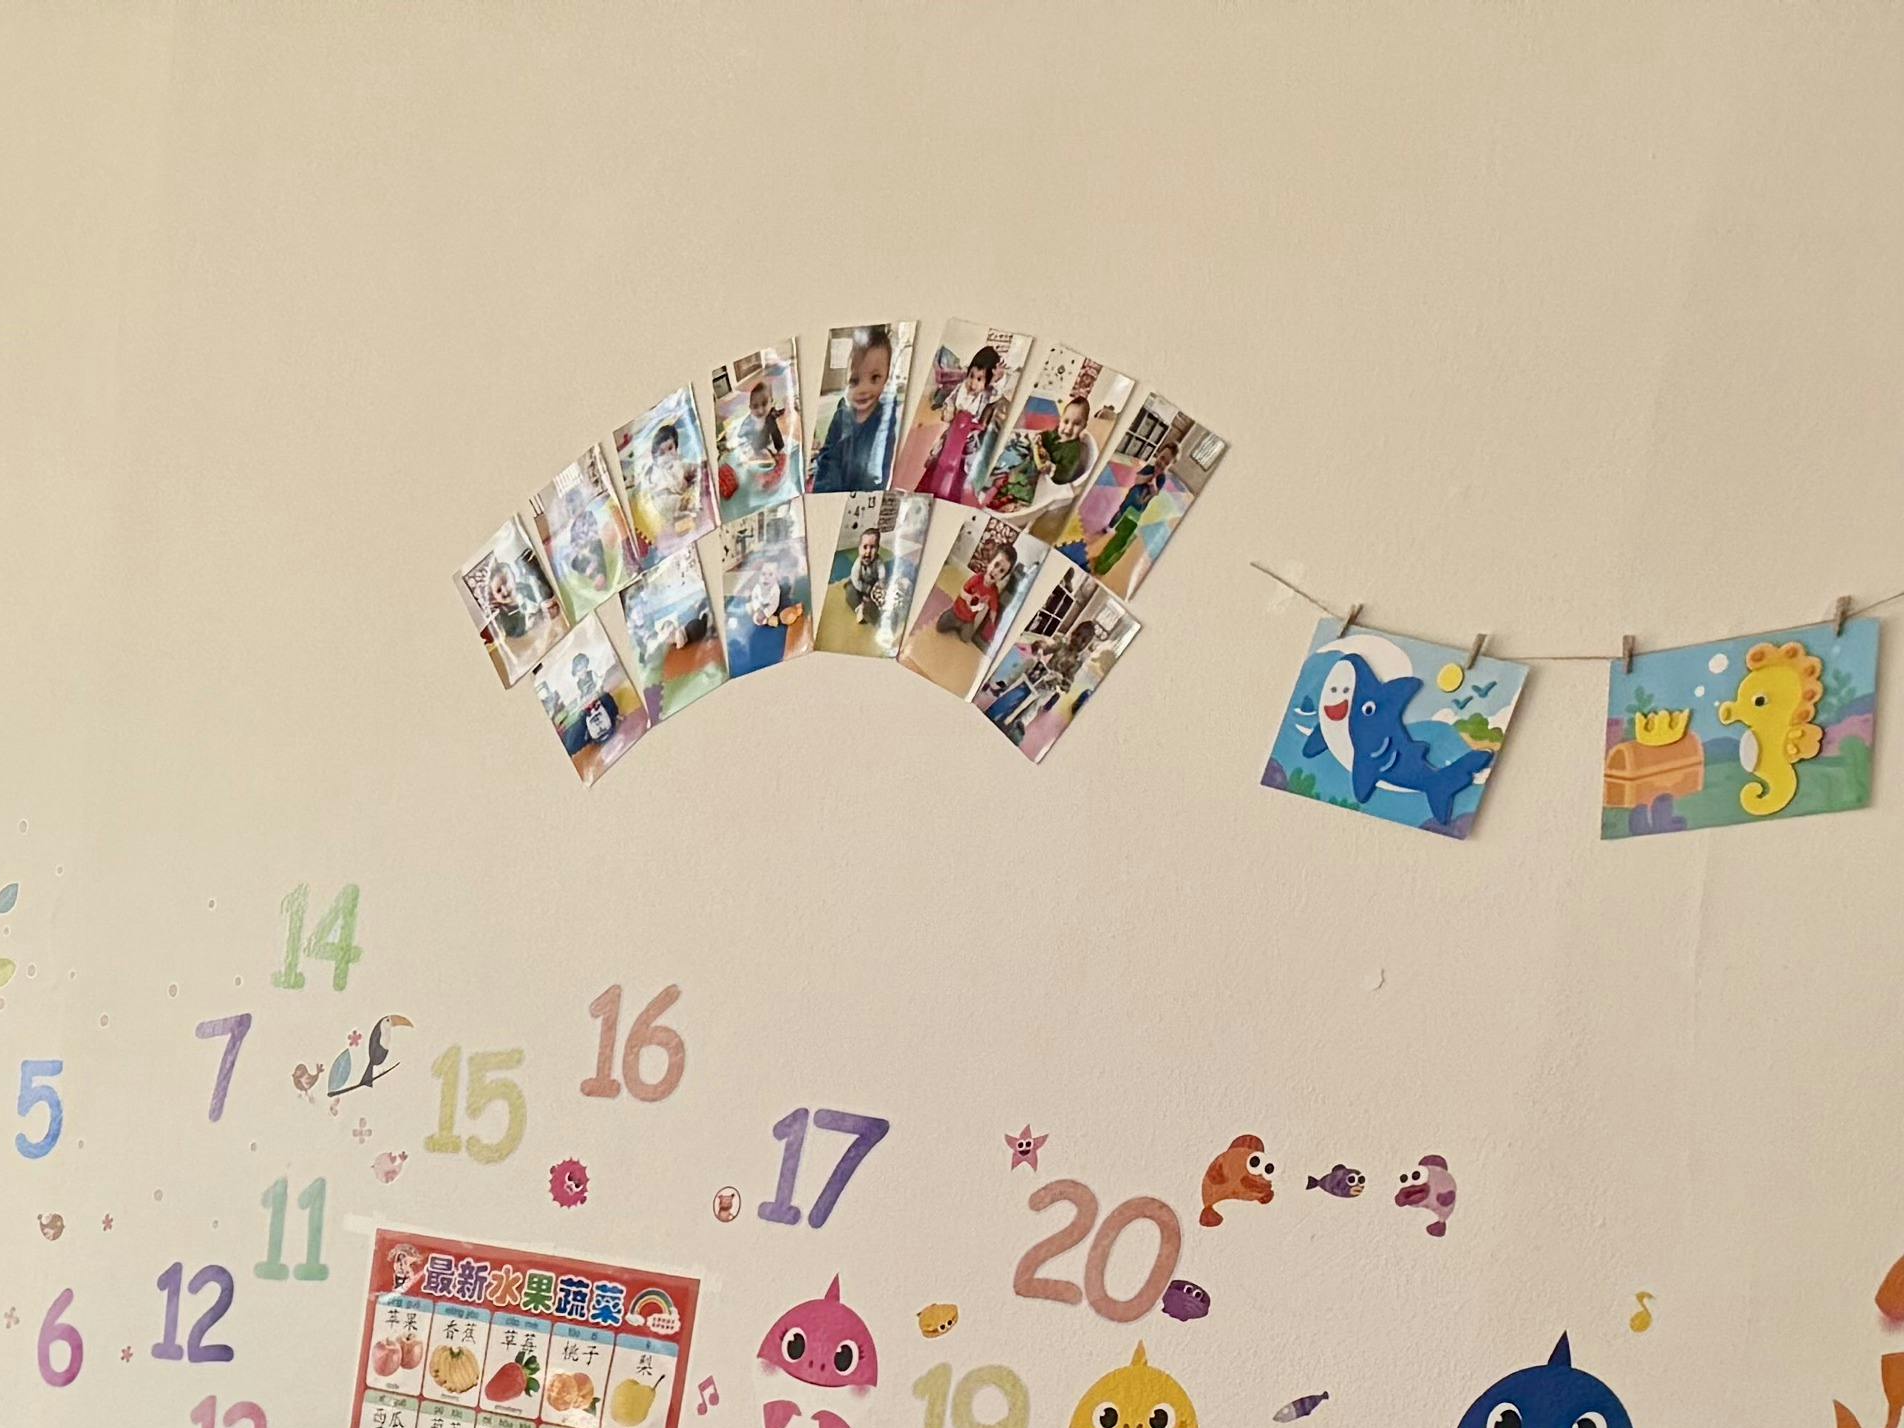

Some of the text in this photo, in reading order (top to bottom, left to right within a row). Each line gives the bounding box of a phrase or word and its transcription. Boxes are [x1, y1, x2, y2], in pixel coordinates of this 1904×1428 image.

[270, 883, 362, 991] 14
[196, 1013, 252, 1121] 7
[579, 983, 685, 1102] 16
[15, 1059, 63, 1159] 5
[423, 1044, 528, 1164] 15
[757, 1106, 890, 1229] 17
[254, 1176, 330, 1281] 11
[1015, 1179, 1184, 1323] 20
[37, 1288, 84, 1388] 6
[151, 1262, 235, 1363] 12
[423, 1255, 625, 1326] 最新水果蔬菜
[443, 1320, 476, 1344] 香蕉
[501, 1329, 537, 1354] 草莓
[562, 1341, 599, 1366] 桃子
[373, 1408, 404, 1428] 西瓜
